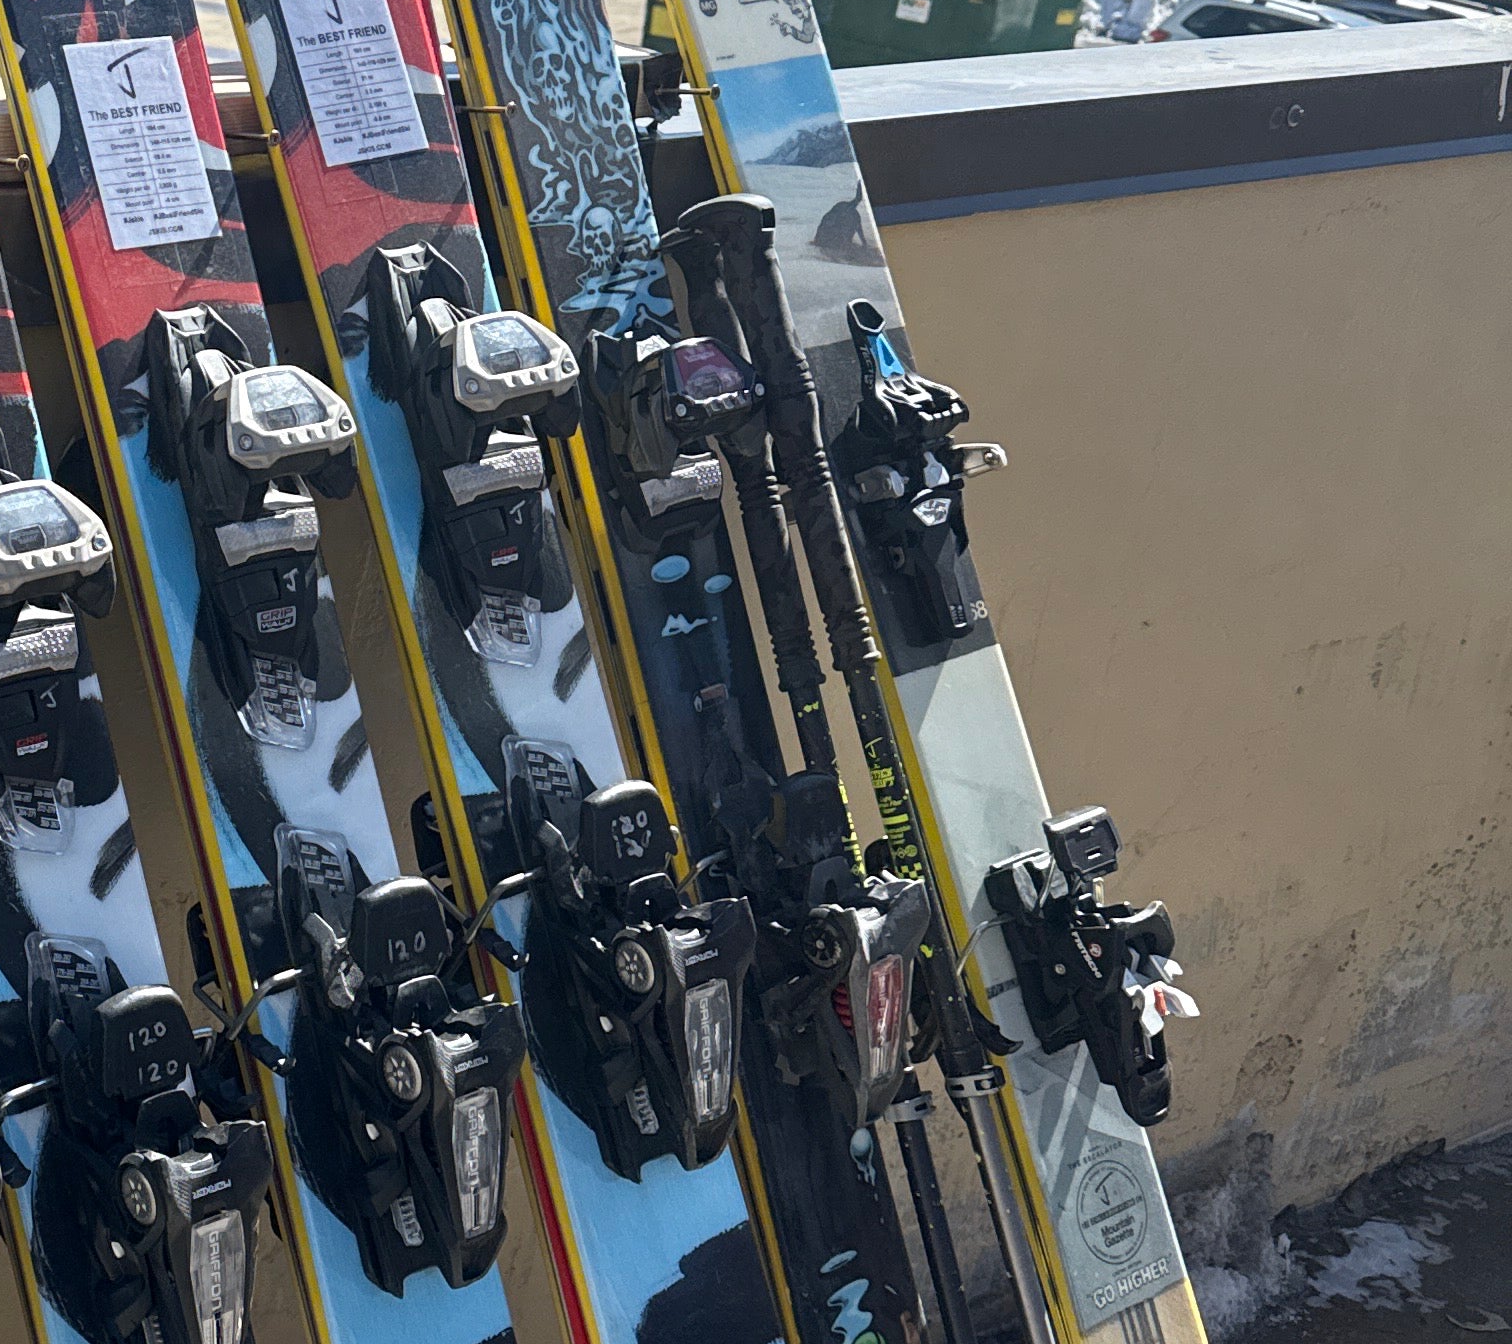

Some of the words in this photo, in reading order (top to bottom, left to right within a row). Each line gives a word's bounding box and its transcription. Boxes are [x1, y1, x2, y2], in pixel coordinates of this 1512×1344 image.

[701, 0, 716, 10] MG
[297, 37, 316, 47] The
[318, 30, 345, 43] BEST
[348, 24, 386, 38] FRIEND
[108, 46, 149, 99] J
[89, 111, 108, 121] The
[111, 106, 138, 119] BEST
[142, 102, 181, 115] FRIEND
[283, 568, 299, 592] J
[260, 608, 293, 621] GRIP
[261, 617, 292, 630] WALK
[40, 681, 59, 708] J
[388, 931, 426, 963] 120
[129, 1021, 166, 1052] 120
[699, 997, 712, 1074] GRIFFON
[139, 1060, 178, 1084] 120
[1068, 1161, 1081, 1169] THE
[1083, 1141, 1122, 1164] ESCALATOR
[1101, 1215, 1135, 1237] Mountain
[1104, 1228, 1134, 1248] Gazette
[208, 1230, 222, 1312] GRIFFON
